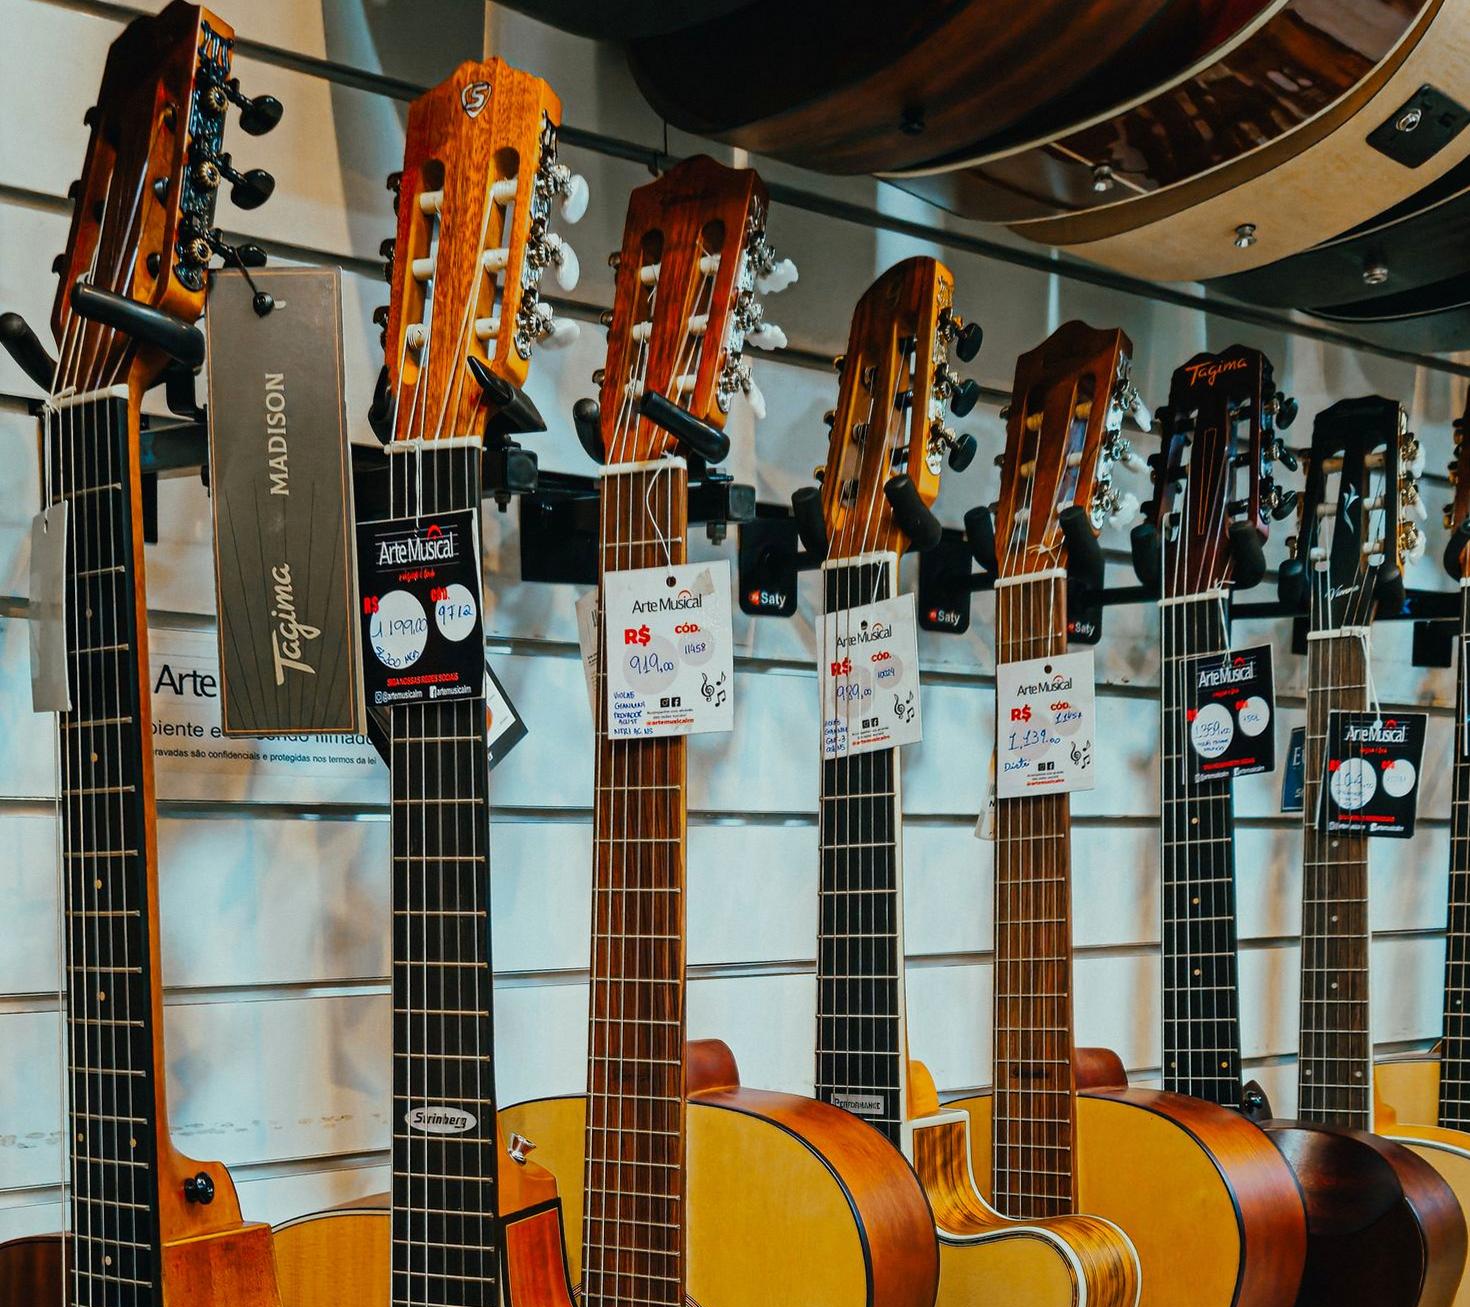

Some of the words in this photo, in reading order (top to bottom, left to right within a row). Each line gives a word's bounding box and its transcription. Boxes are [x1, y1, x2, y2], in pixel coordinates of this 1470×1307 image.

[1185, 358, 1247, 386] Tagima
[265, 372, 290, 497] MADISON
[632, 600, 658, 614] Arte
[660, 594, 703, 611] Musical
[761, 592, 786, 609] Saty
[271, 562, 321, 686] Tagima
[937, 609, 960, 626] Saty
[624, 624, 651, 647] R$
[674, 622, 701, 634] CÓD.
[1075, 622, 1095, 637] Saty
[629, 652, 674, 674] 919,00
[831, 657, 852, 676] R$
[871, 651, 892, 662] CÓD.
[154, 664, 217, 697] Arte
[1017, 685, 1037, 697] Arte
[1038, 677, 1073, 693] Musical
[1011, 704, 1032, 722] R$
[1050, 700, 1072, 711] CÓD.
[153, 748, 188, 758] ravadas
[190, 749, 206, 758] são
[208, 750, 261, 761] confidenciais
[270, 753, 310, 764] protegidas
[312, 755, 327, 763] nos
[329, 756, 354, 764] termos
[356, 756, 366, 764] da
[367, 756, 377, 765] lei
[413, 1111, 467, 1129] Strinberg
